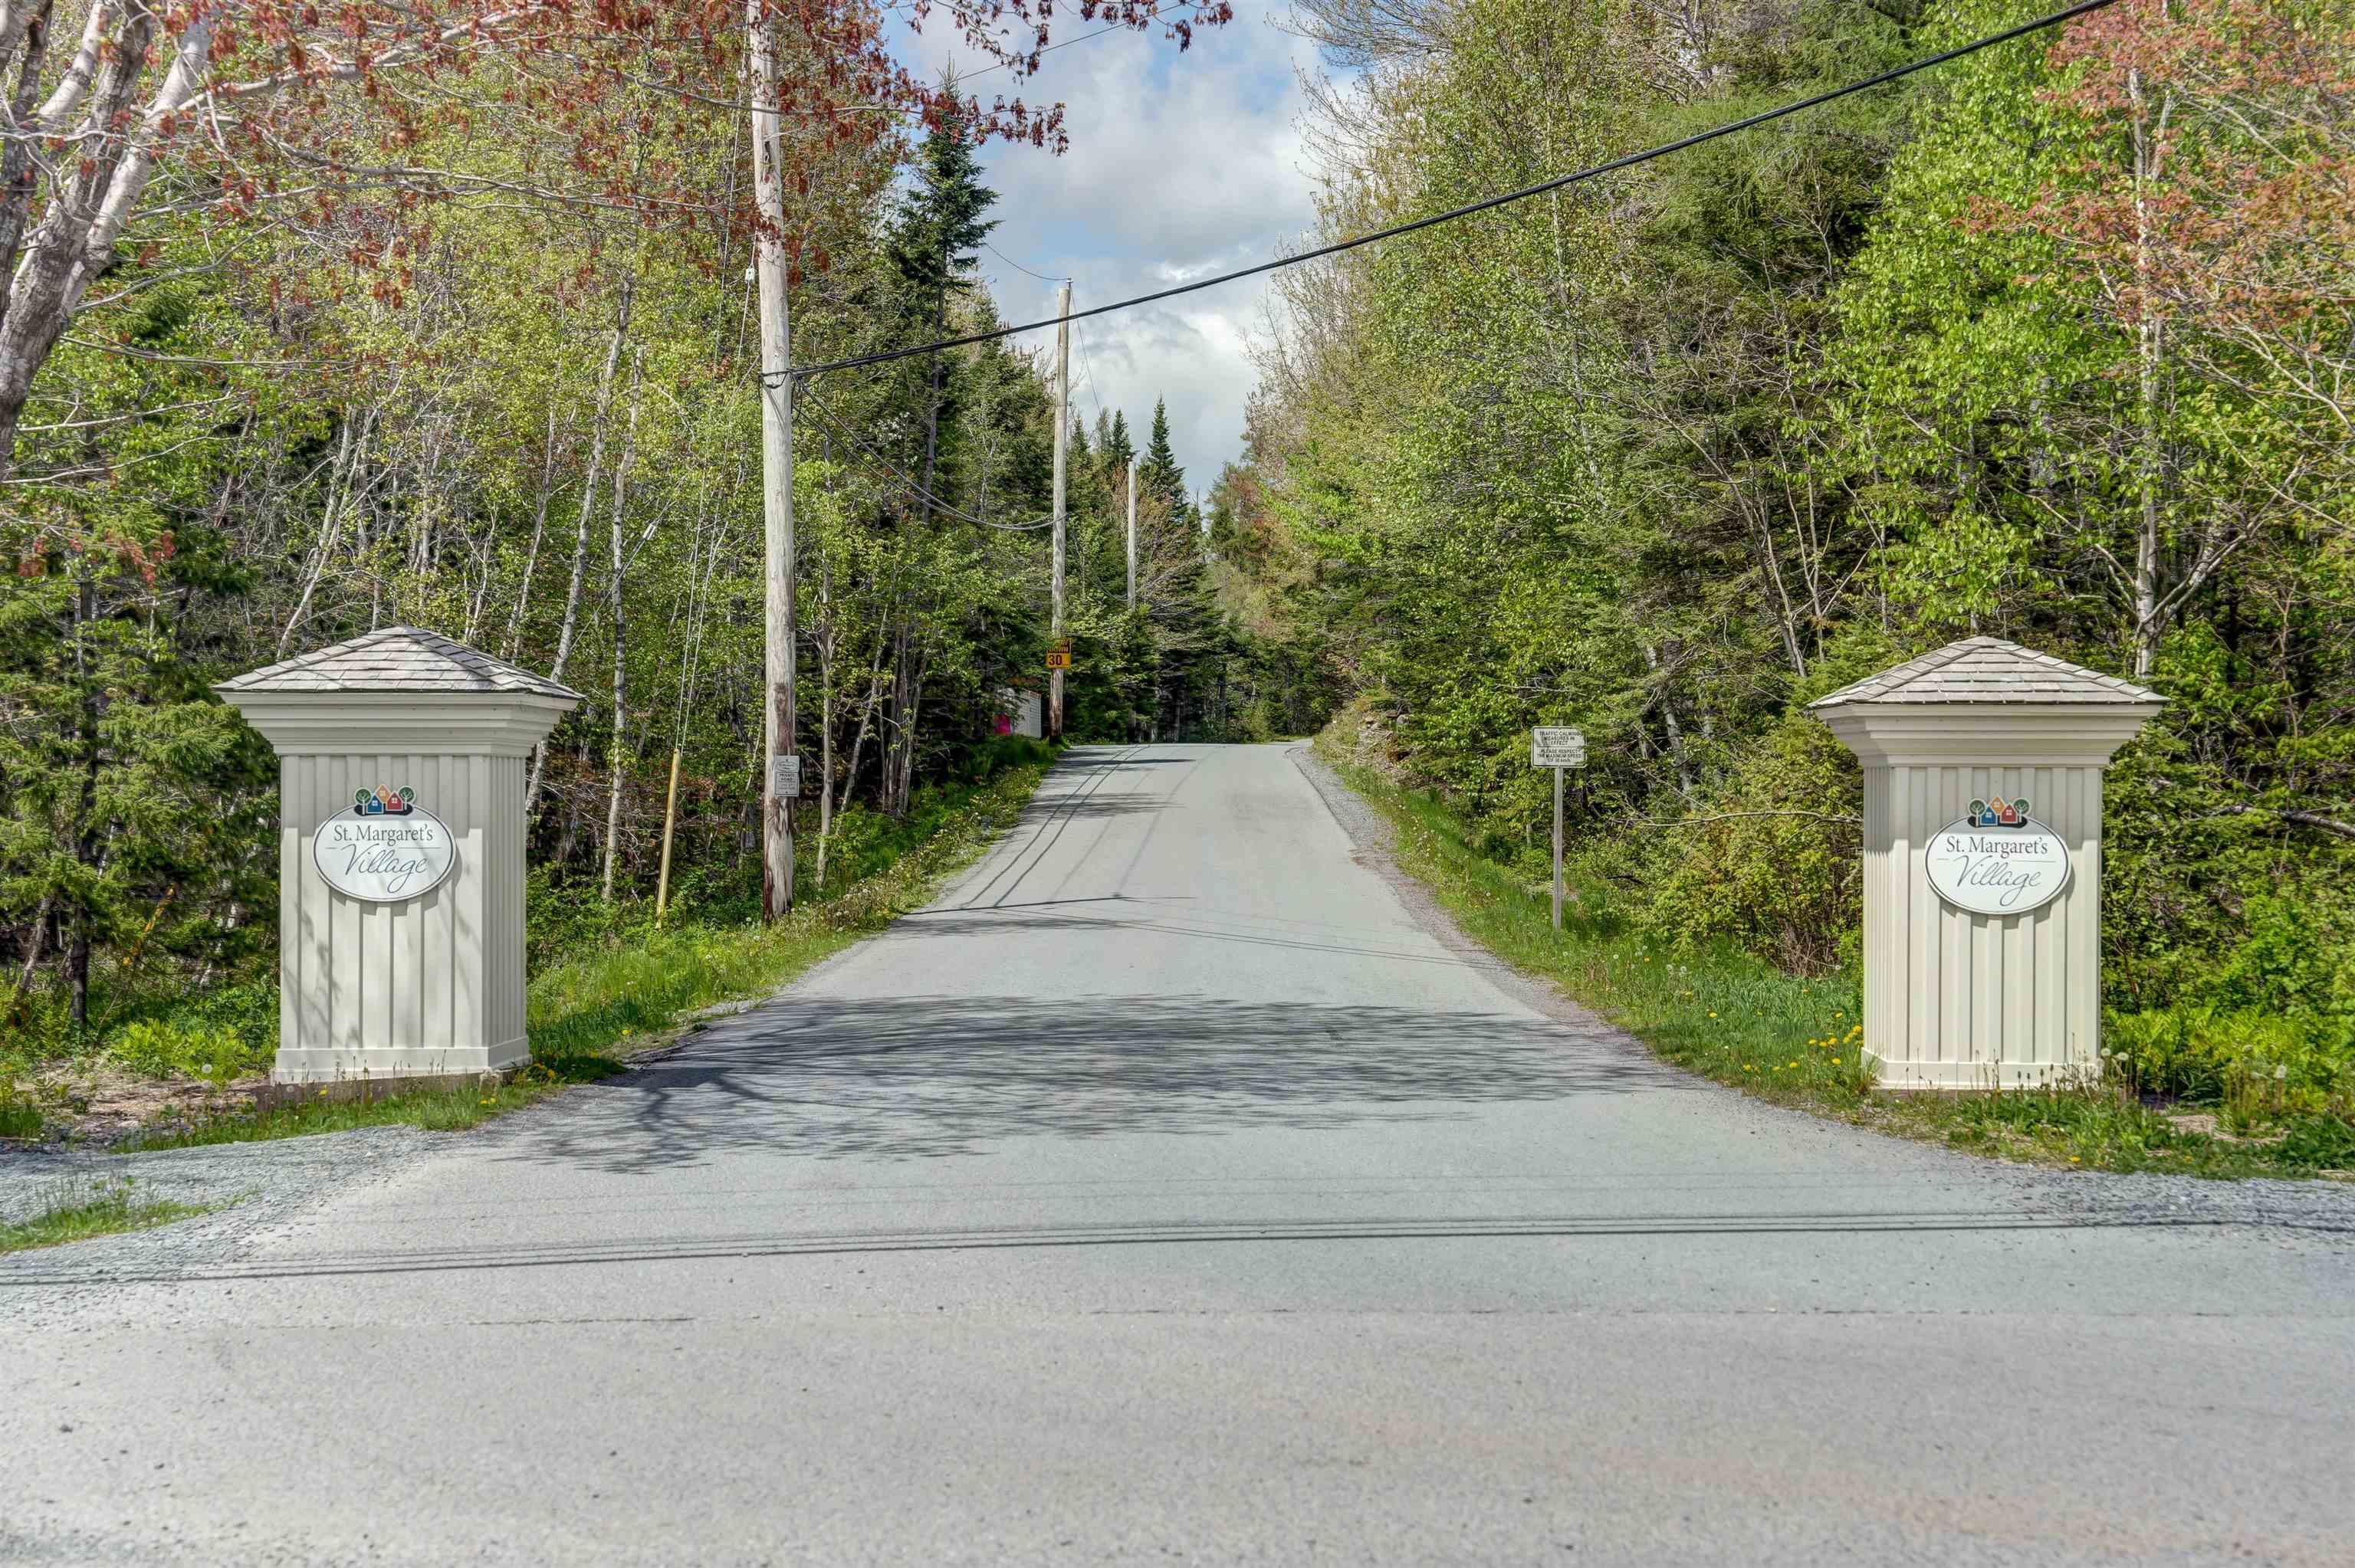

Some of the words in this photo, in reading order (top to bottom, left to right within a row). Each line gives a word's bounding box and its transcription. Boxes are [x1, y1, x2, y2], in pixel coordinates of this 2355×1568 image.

[1048, 654, 1063, 665] 30
[333, 825, 352, 841] St.
[356, 824, 434, 846] Margaret's
[1946, 835, 1965, 853] St.
[1969, 836, 2048, 859] Margaret's
[340, 843, 429, 894] Village
[1953, 855, 2041, 907] Village
